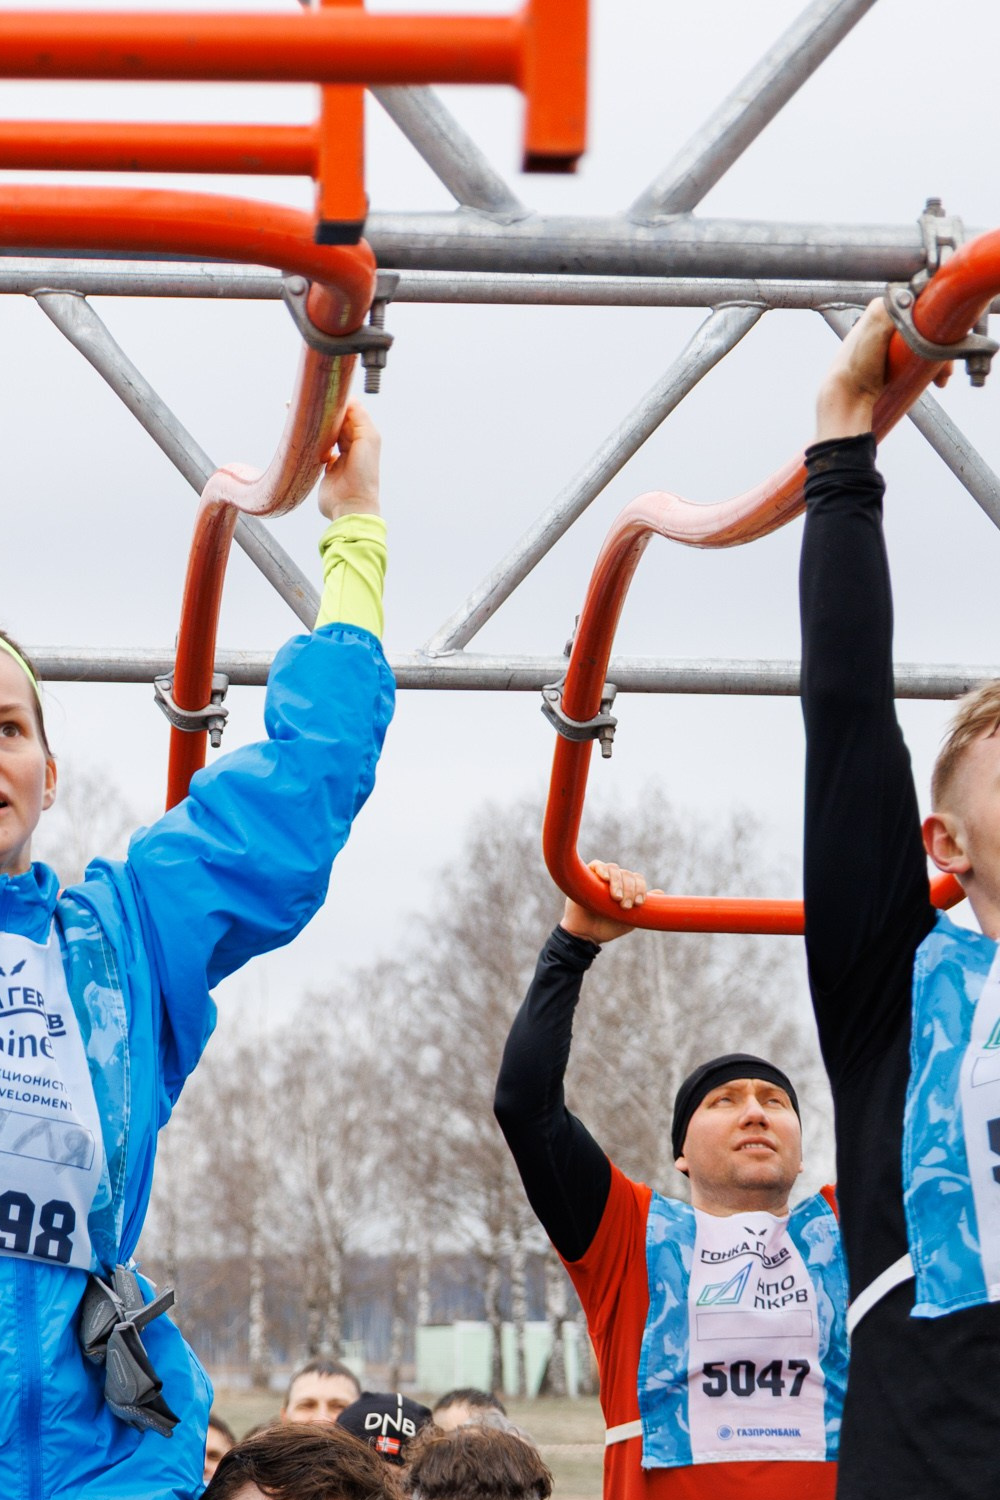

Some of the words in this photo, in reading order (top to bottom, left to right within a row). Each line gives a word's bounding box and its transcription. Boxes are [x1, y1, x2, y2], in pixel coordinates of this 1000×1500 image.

[701, 1241, 750, 1261] ГОНКА
[754, 1289, 808, 1309] ПКРВ
[702, 1360, 811, 1398] 5047
[364, 1402, 417, 1437] DNB
[736, 1427, 802, 1438] ГАЗПРОМБАНК
